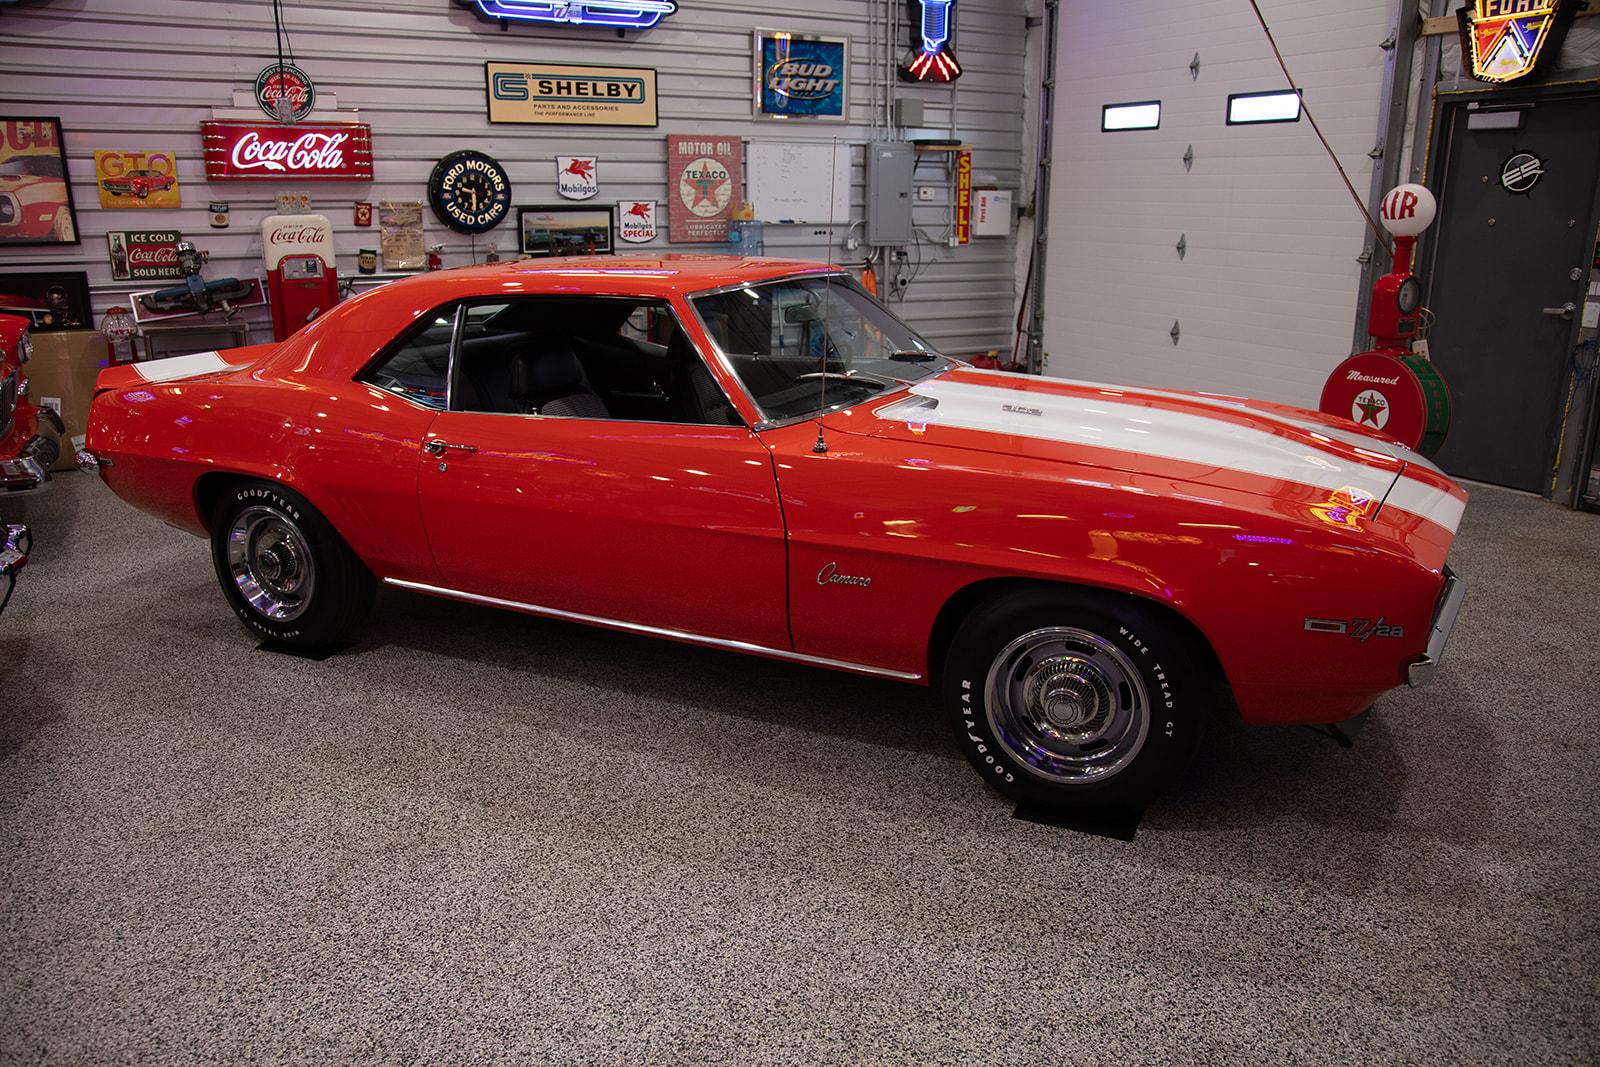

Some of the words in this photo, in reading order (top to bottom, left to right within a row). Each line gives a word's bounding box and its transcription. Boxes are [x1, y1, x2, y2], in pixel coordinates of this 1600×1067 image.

[781, 63, 832, 78] BUD
[538, 80, 638, 98] SHELBY
[768, 77, 839, 93] LIGHT
[231, 132, 349, 172] Coca-Cola
[678, 142, 713, 155] MOTOR
[716, 142, 731, 155] OIL
[100, 152, 173, 177] GTO
[443, 163, 464, 191] FORD
[466, 160, 505, 192] MOTORS
[685, 170, 727, 179] TEXACO
[561, 183, 597, 195] Mobilgas
[958, 156, 971, 242] SHELL
[446, 201, 475, 225] USED
[477, 202, 503, 225] CARS
[623, 230, 654, 238] SPECIAL
[624, 222, 653, 230] Mobilgas
[131, 233, 146, 243] ICE
[149, 233, 175, 243] COLD
[270, 226, 326, 245] Coca-Cola
[129, 247, 178, 263] Coca-Cola
[134, 268, 156, 277] SOLD
[157, 267, 181, 276] HERE
[1346, 369, 1400, 385] Measured
[237, 488, 300, 520] GOODYEAR
[816, 561, 872, 587] Camaro
[1119, 626, 1150, 655] WIDE
[1153, 663, 1174, 709] TREAD
[1165, 721, 1175, 737] GT
[961, 679, 1015, 783] GOODYEAR
